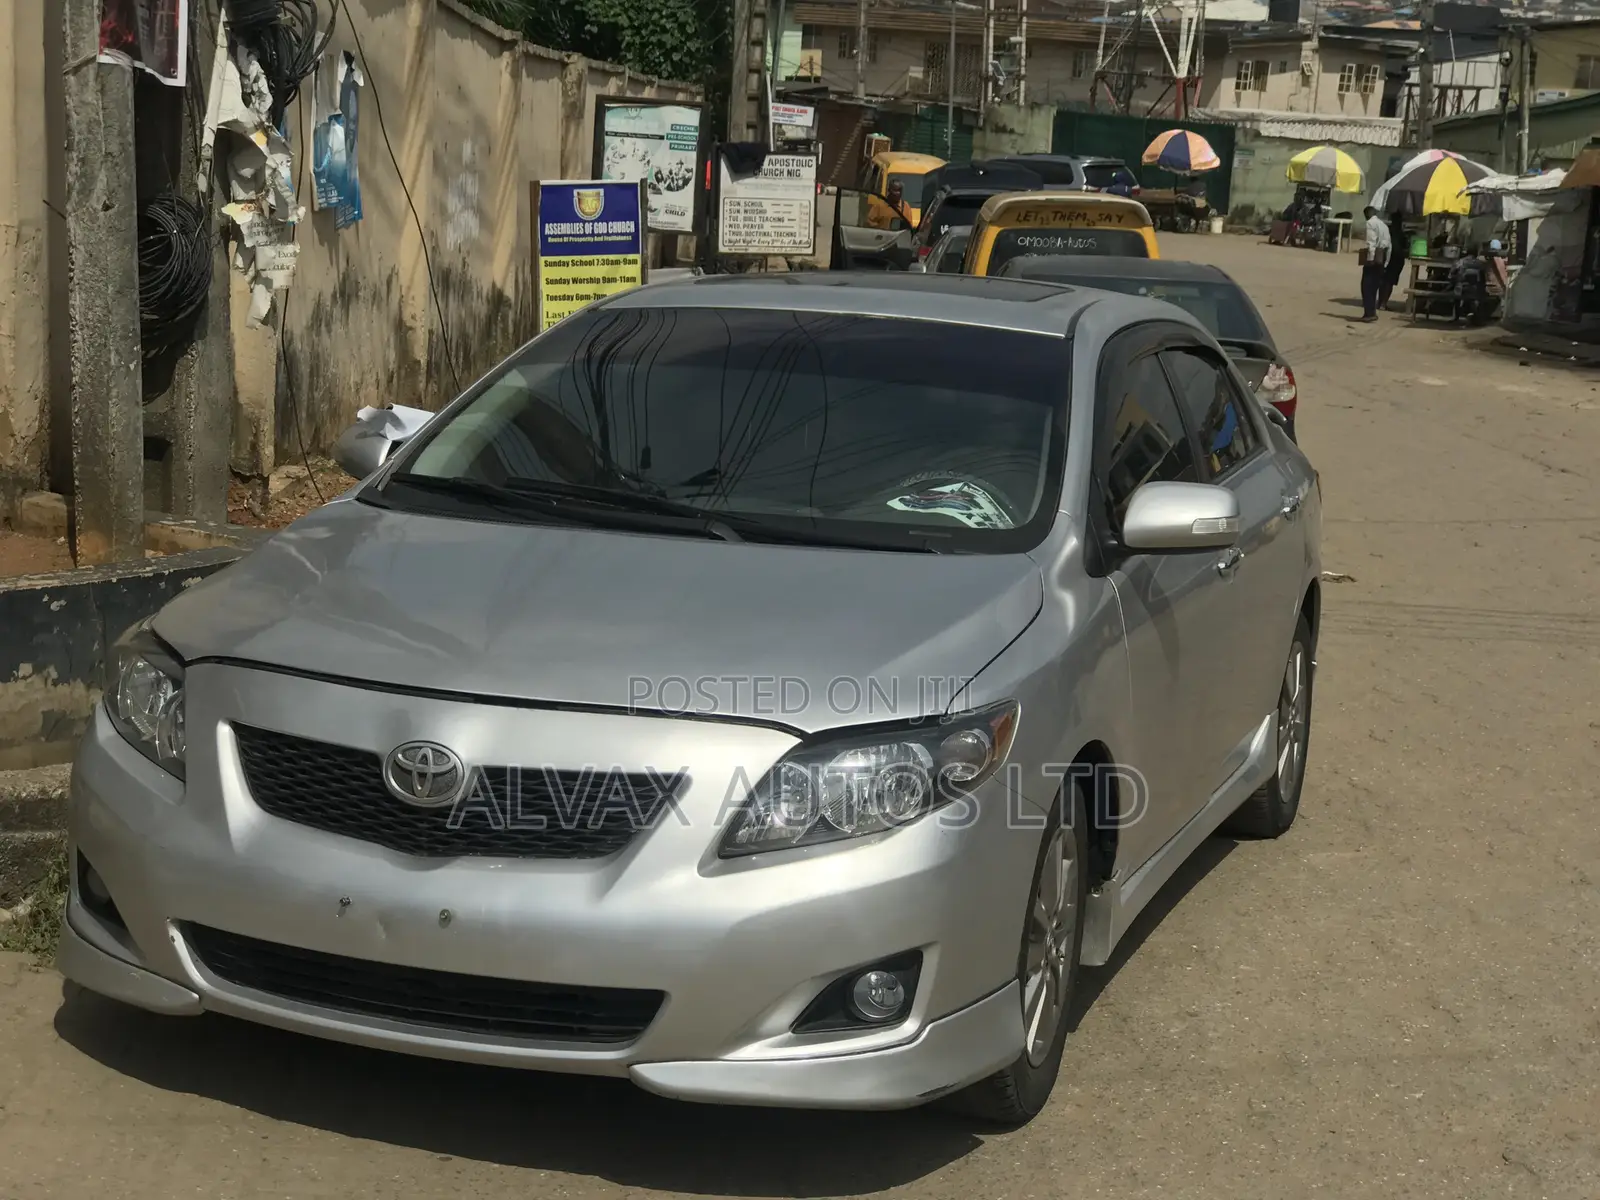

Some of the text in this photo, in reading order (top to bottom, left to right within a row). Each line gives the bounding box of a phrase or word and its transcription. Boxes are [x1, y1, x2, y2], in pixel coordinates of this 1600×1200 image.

[767, 158, 814, 168] APOSTOLIC
[753, 168, 785, 177] CHURCH
[664, 209, 686, 217] CHILD
[1015, 210, 1039, 223] LET
[1051, 210, 1088, 222] THEM
[1097, 211, 1125, 224] SAY
[544, 222, 584, 235] ASSEMBLIES
[584, 222, 593, 234] OF
[593, 221, 607, 234] GOD
[608, 220, 635, 233] CHURCH
[544, 259, 570, 268] Sunday
[570, 258, 595, 267] School
[545, 275, 637, 286] Sunday Worship 9am-11am
[546, 294, 574, 302] Tuesday
